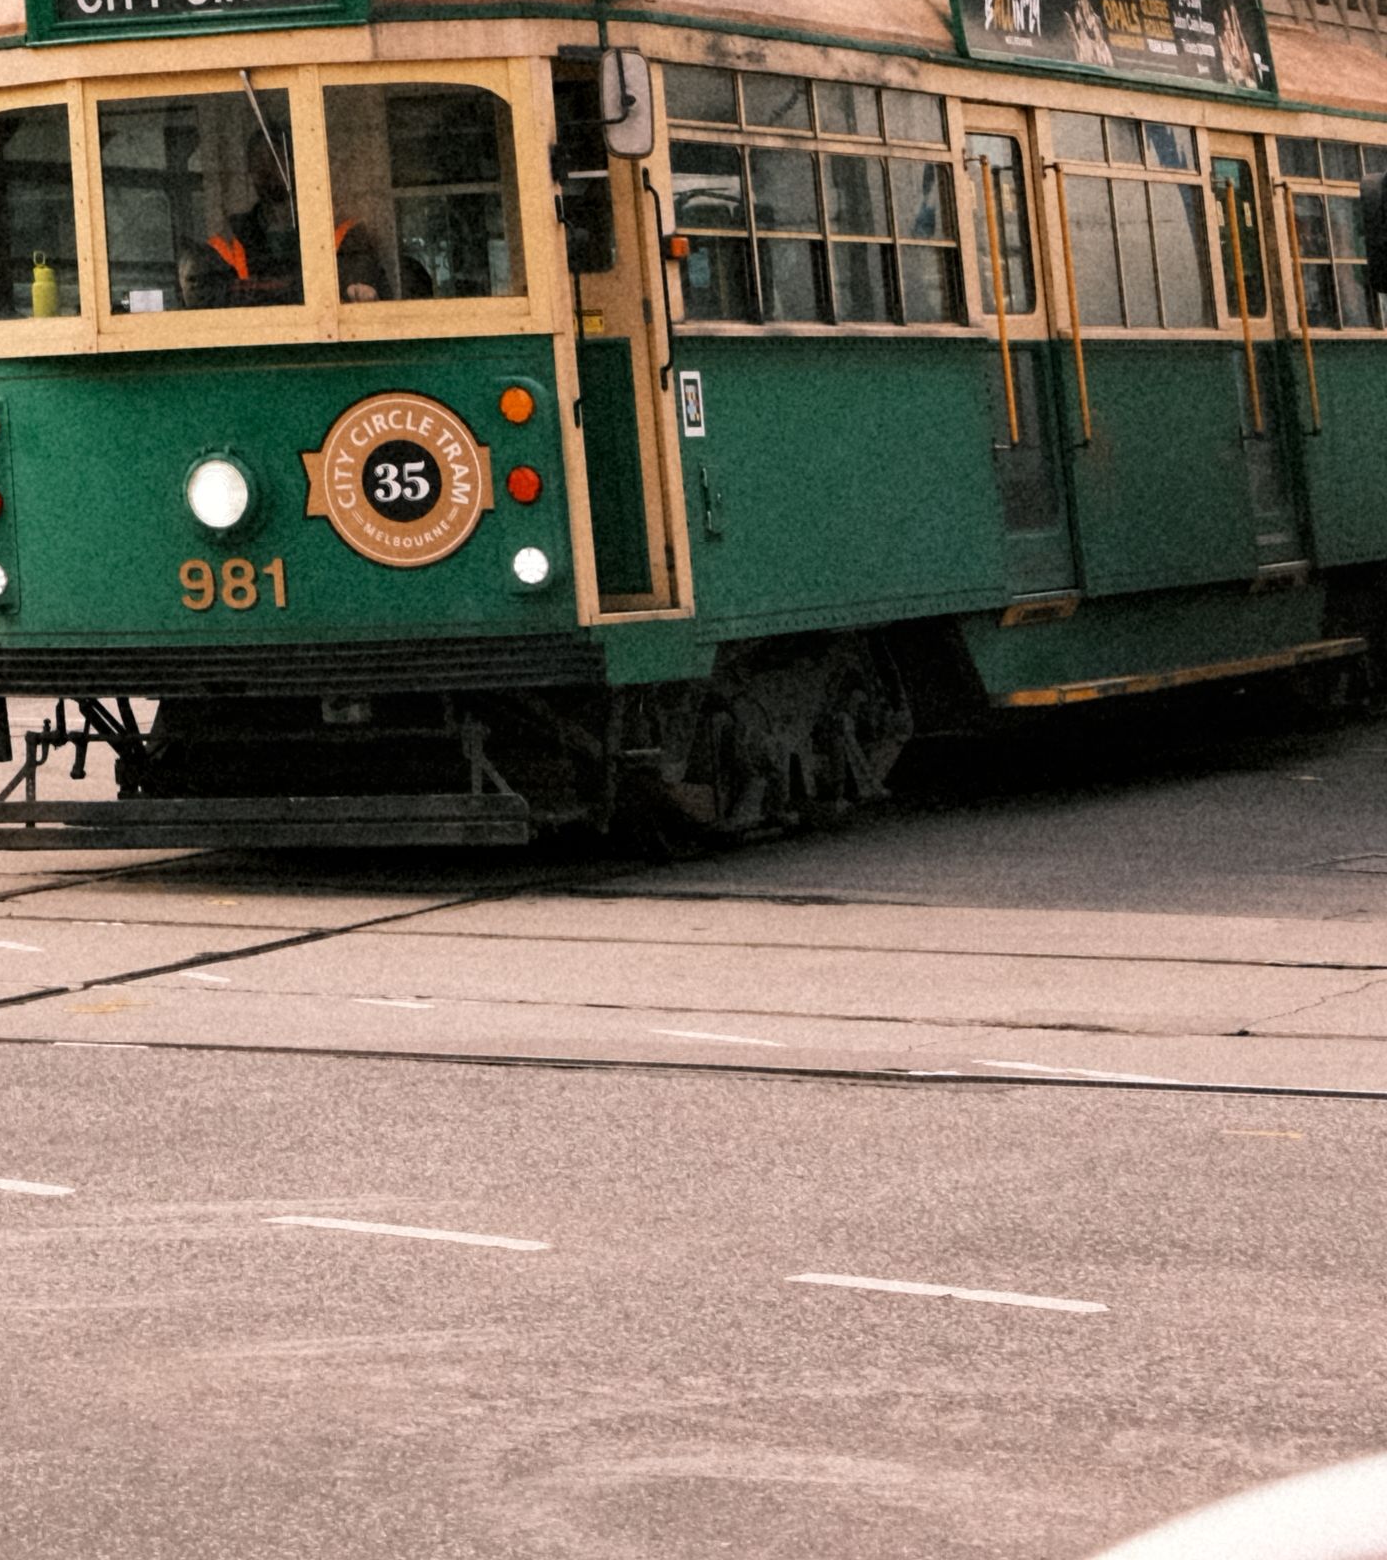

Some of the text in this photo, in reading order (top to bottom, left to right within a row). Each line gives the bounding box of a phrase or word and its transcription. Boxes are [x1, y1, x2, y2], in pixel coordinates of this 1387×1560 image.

[335, 410, 472, 509] CITY CIRCLE TRAM
[373, 460, 430, 502] 35
[363, 519, 451, 548] MELBOURNE
[178, 557, 287, 611] 981
